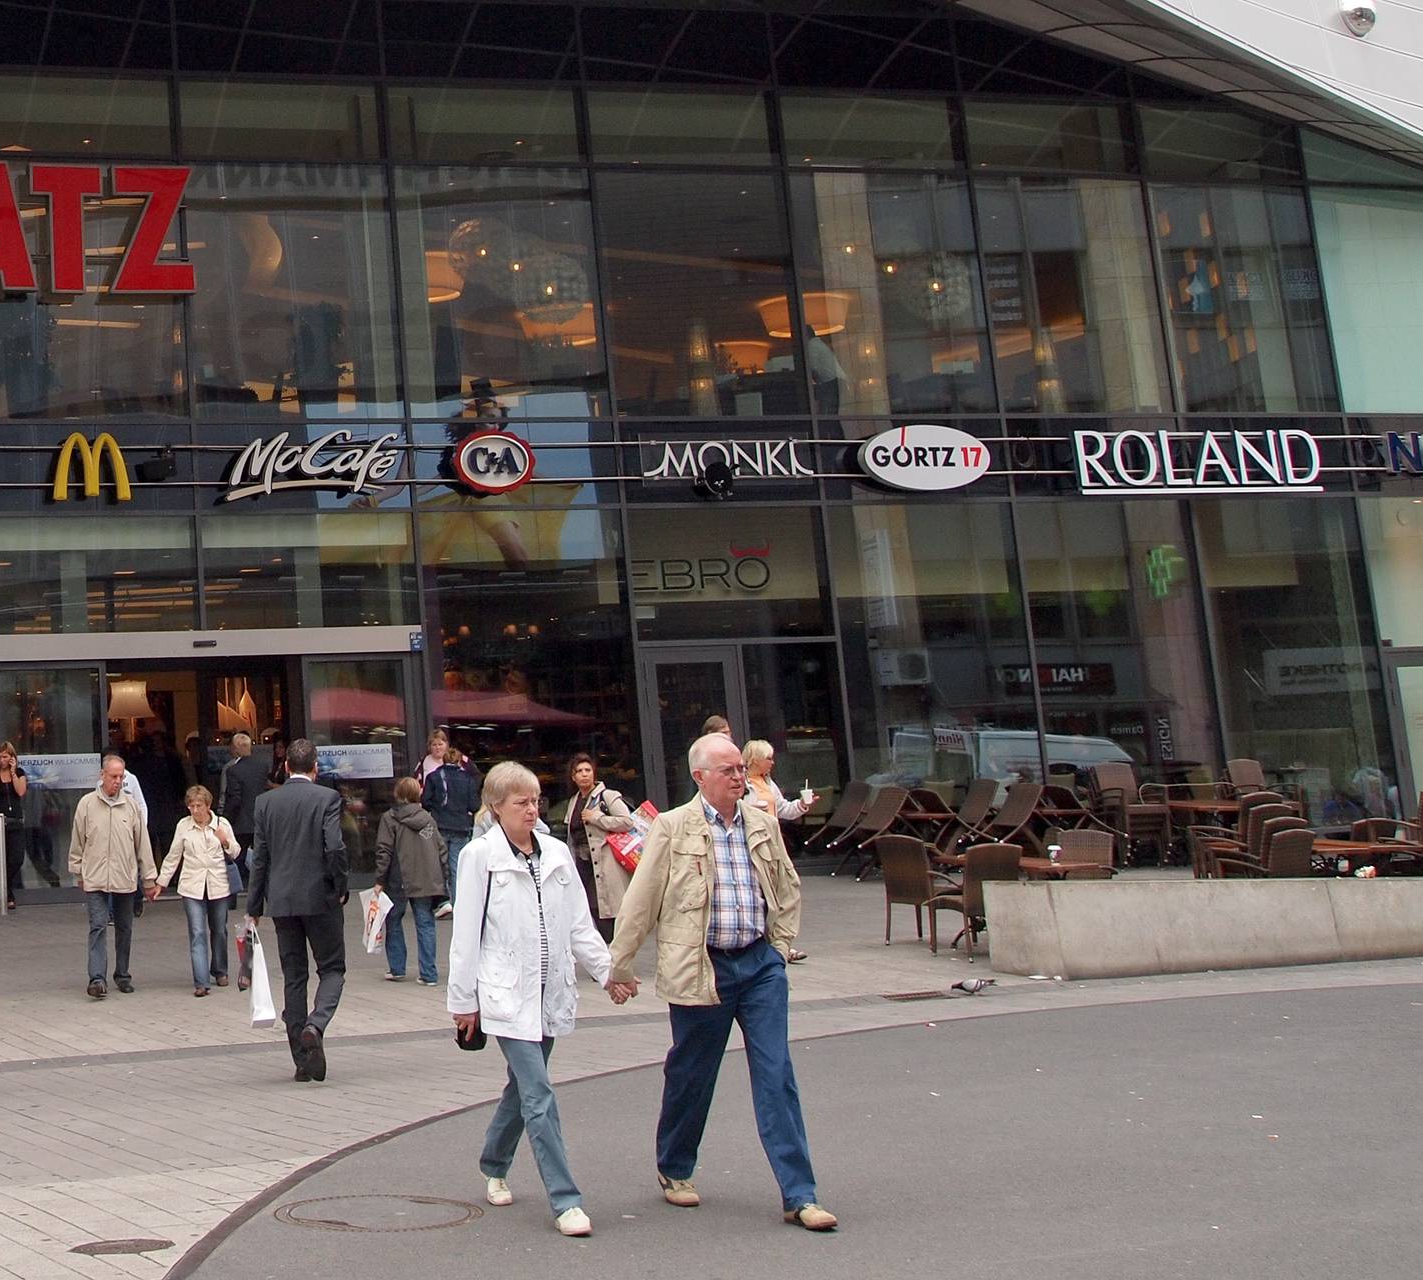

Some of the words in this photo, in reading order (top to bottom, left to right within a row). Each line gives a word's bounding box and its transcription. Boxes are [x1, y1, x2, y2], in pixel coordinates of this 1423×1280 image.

[229, 429, 400, 495] McCafé
[466, 446, 521, 476] C&A
[643, 439, 815, 477] MONKI
[960, 446, 983, 468] 17
[1074, 428, 1320, 488] ROLAND
[319, 749, 348, 757] ERZLICH
